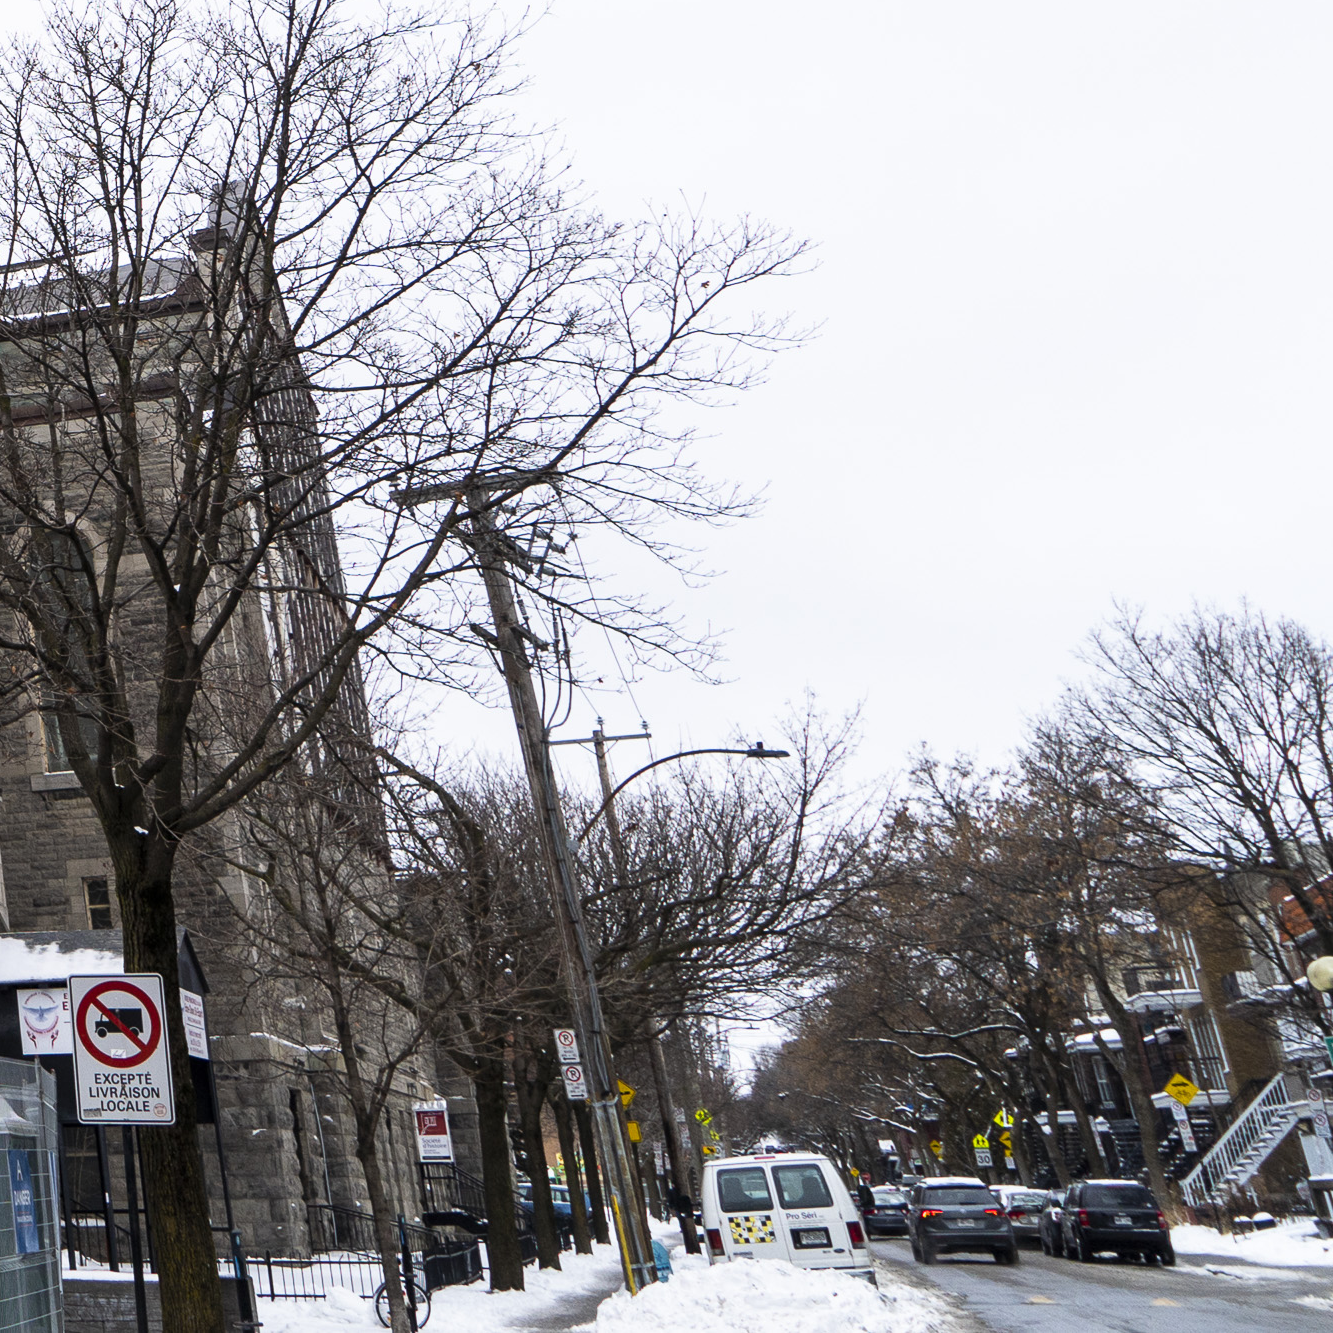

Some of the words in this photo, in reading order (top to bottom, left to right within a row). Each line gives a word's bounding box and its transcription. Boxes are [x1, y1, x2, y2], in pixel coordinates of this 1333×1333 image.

[94, 1071, 152, 1085] EXCEPTÉ
[89, 1086, 160, 1099] LIVRAISON
[100, 1100, 150, 1112] LOCALE
[978, 1155, 991, 1164] 30
[786, 1212, 800, 1220] Pro
